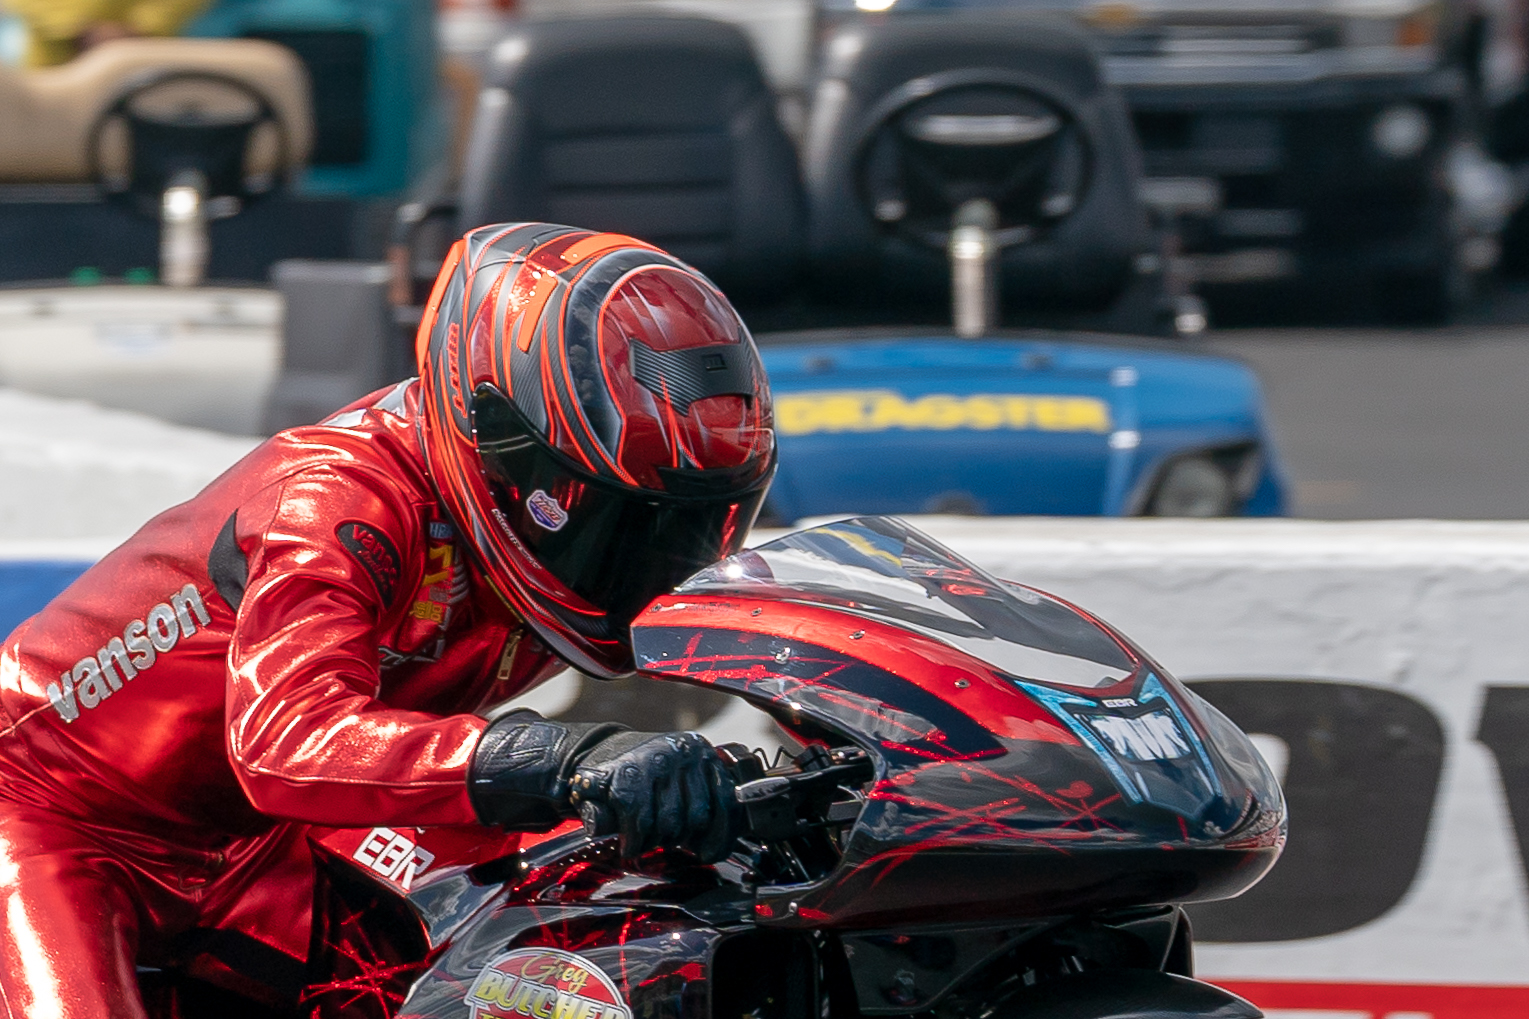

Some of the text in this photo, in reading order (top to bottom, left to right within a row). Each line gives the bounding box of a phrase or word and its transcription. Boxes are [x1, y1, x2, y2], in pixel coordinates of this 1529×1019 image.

[46, 583, 213, 724] vanson
[353, 826, 435, 890] EBR
[521, 954, 589, 993] Greg
